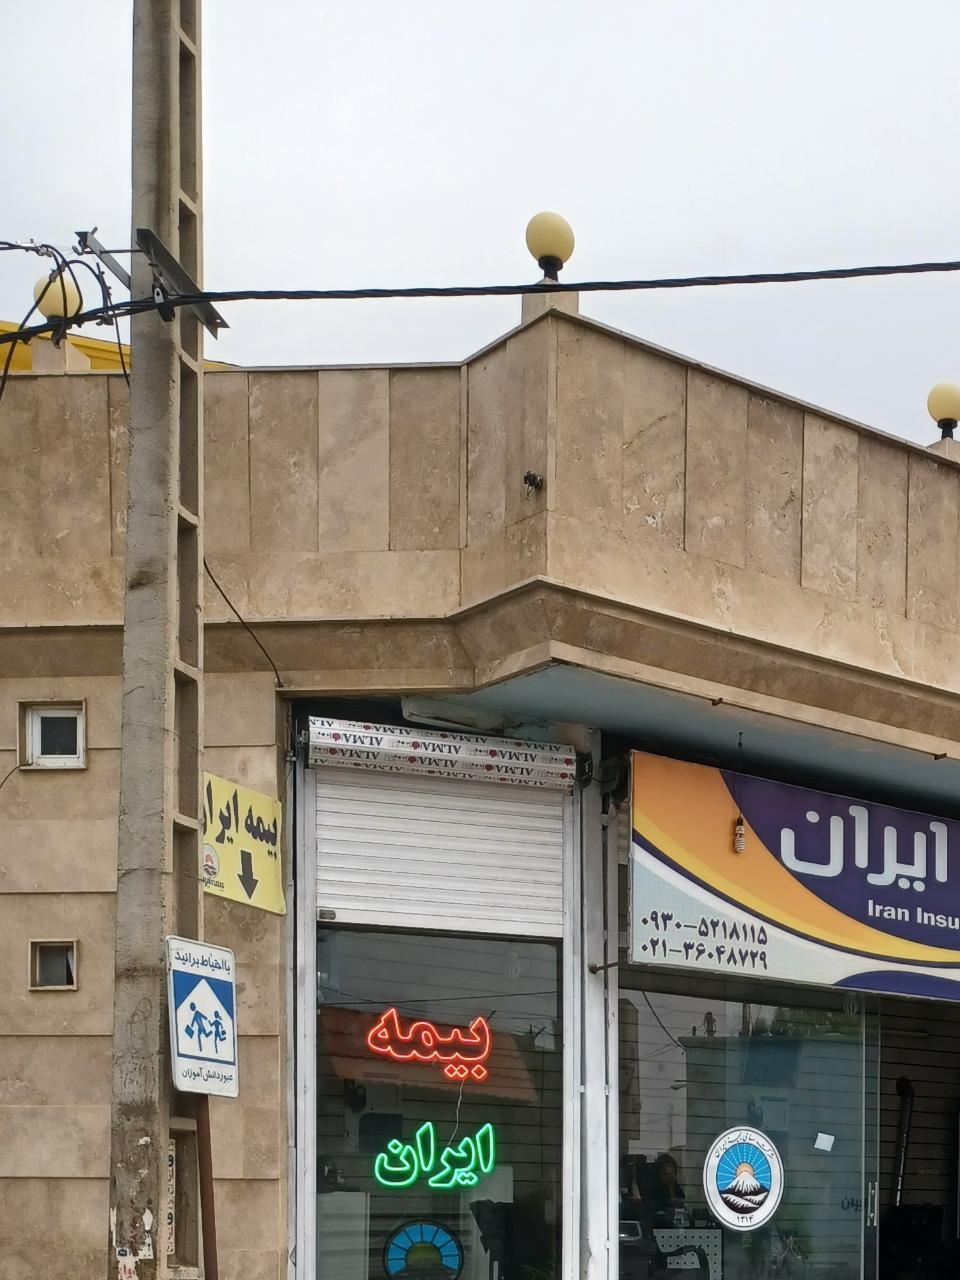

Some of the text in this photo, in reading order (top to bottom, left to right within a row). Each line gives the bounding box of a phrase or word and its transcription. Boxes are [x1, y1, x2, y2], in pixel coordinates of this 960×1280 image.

[343, 733, 383, 746] ALMA
[339, 748, 380, 760] ALMA
[421, 742, 462, 755] ALMA
[418, 756, 458, 769] ALMA
[499, 750, 538, 763] ALMA
[495, 765, 535, 776] ALMA
[245, 805, 277, 860] بیمه
[781, 805, 948, 892] ایران
[868, 899, 910, 922] Iran
[174, 951, 200, 968] برانید
[367, 1008, 491, 1079] بیمه
[374, 1121, 495, 1188] ایران
